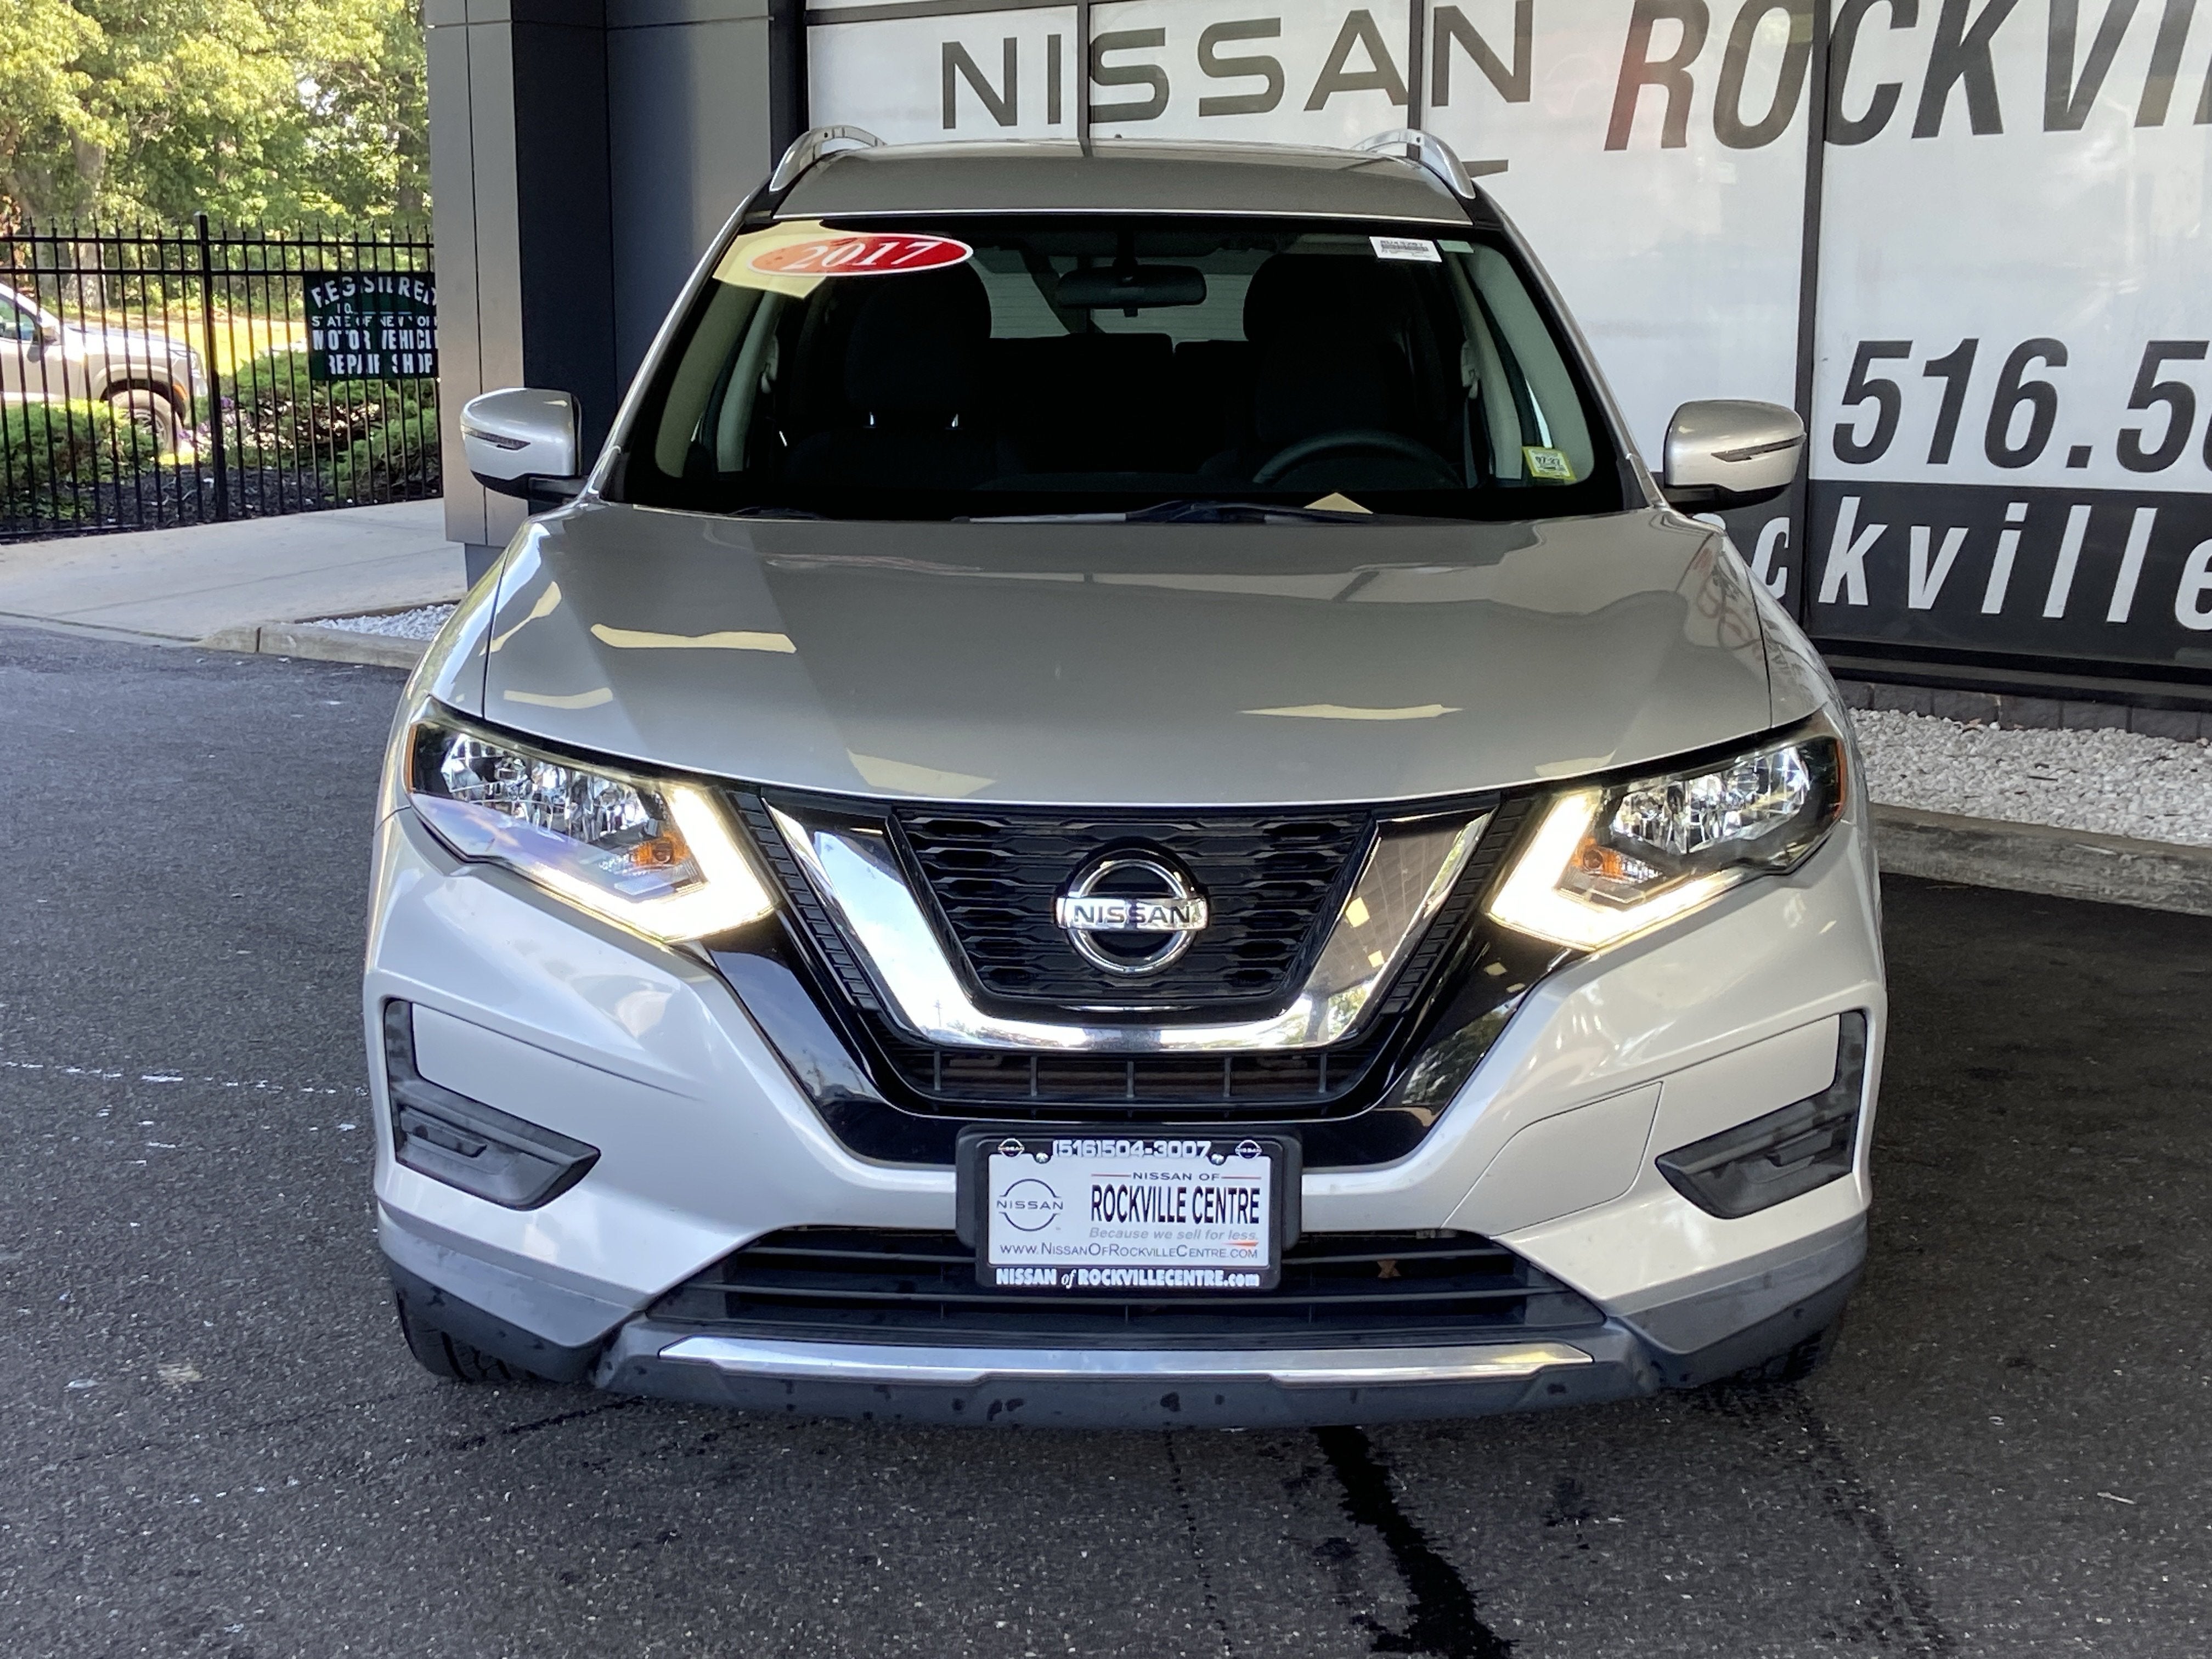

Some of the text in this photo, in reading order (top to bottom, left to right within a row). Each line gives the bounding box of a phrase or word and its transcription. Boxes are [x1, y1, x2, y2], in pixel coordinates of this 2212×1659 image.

[942, 0, 1532, 130] NISSAN
[781, 241, 944, 270] 2017
[312, 315, 352, 327] SATE
[1832, 337, 2212, 473] 516.5
[1692, 495, 2212, 630] ckville
[1074, 905, 1190, 924] NISSAN
[1052, 1139, 1211, 1159] (516)504-3007
[1133, 1172, 1192, 1180] NISSAN
[996, 1200, 1064, 1210] NISSAN
[1091, 1183, 1260, 1224] ROCKVILLE CENTRE
[1089, 1227, 1259, 1241] Because we sell for less.
[996, 1268, 1260, 1289] NISSAN of ROCKVILLECENTRE.com
